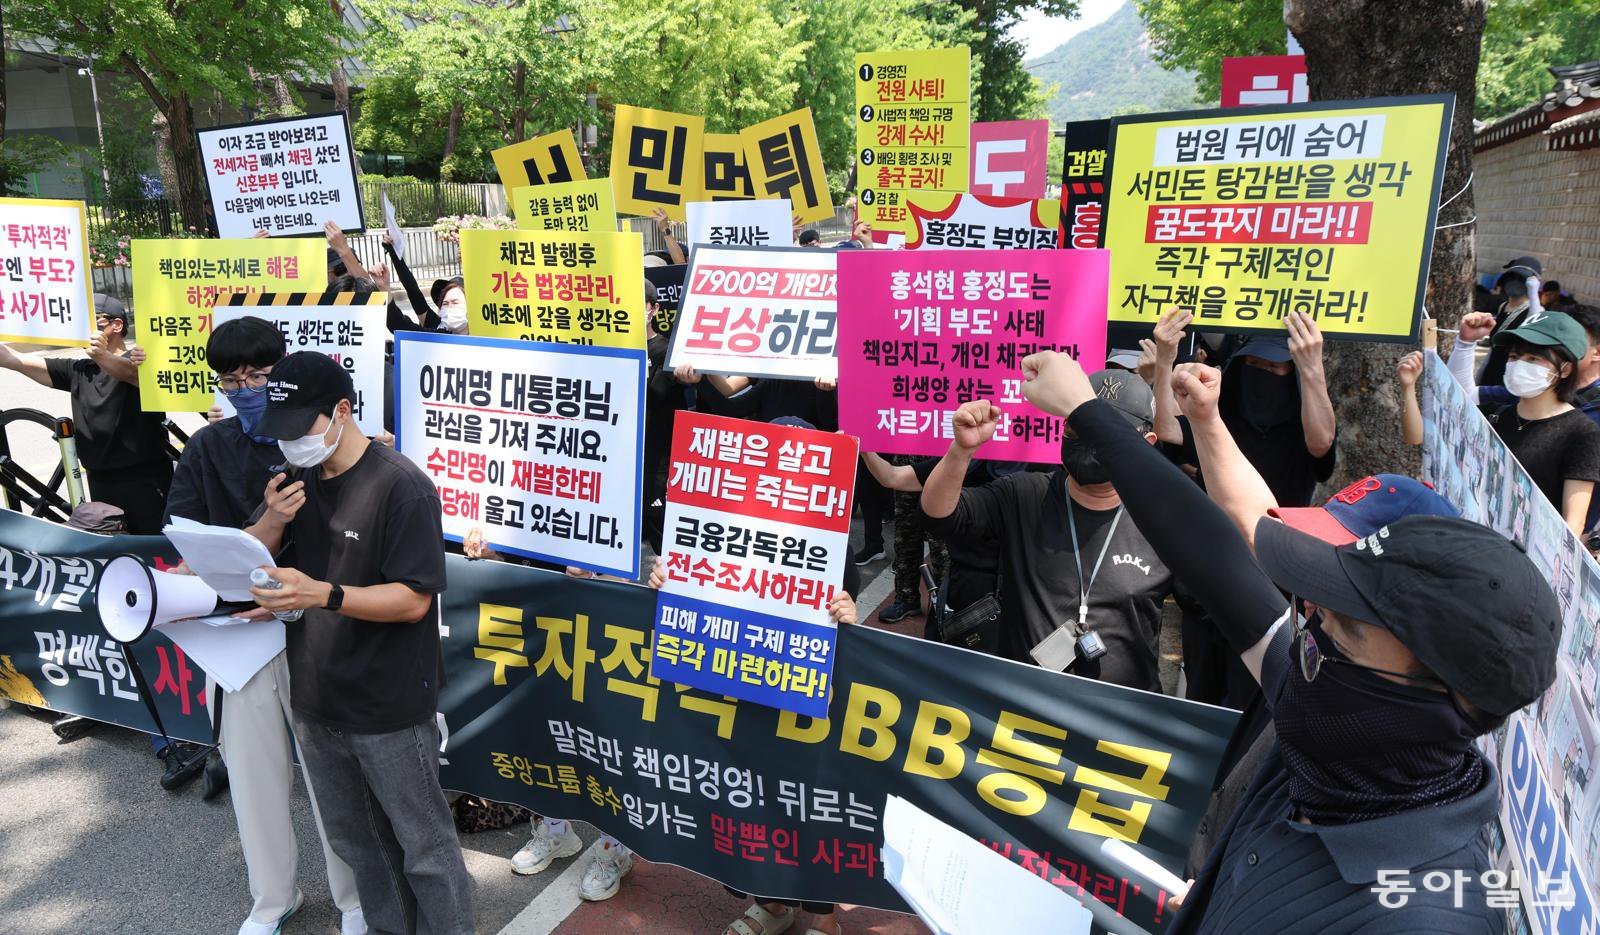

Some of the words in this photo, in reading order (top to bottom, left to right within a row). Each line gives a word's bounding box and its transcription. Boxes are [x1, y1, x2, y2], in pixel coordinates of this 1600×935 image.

[877, 65, 907, 79] 경영진
[877, 79, 906, 102] 전원
[909, 78, 945, 101] 사퇴!
[877, 109, 907, 122] 사법적
[909, 108, 930, 122] 책임
[932, 108, 953, 122] 규명
[218, 135, 242, 153] 이자
[245, 132, 266, 150] 조금
[268, 125, 328, 148] 받아보려고
[877, 124, 906, 146] 강제
[909, 124, 945, 146] 수사!
[1176, 128, 1228, 163] 법원
[1235, 124, 1297, 158] 뒤에
[1304, 120, 1368, 158] 숨어
[212, 154, 259, 176] 전세자금
[261, 152, 286, 168] 빼서
[288, 148, 313, 166] 채권
[315, 144, 340, 165] 샀던
[628, 125, 688, 206] 민
[877, 152, 896, 165] 배임
[899, 152, 917, 165] 횡령
[920, 153, 939, 165] 조사
[942, 153, 952, 165] 및
[1068, 149, 1107, 177] 검찰
[236, 173, 279, 193] 신혼부부
[282, 169, 322, 189] 입니다.
[877, 167, 906, 188] 출국
[909, 167, 944, 189] 금지!
[1127, 168, 1206, 202] 서민돈
[1215, 164, 1336, 200] 탕감받을
[1344, 161, 1412, 198] 생각
[225, 197, 265, 213] 다음달에
[266, 193, 297, 209] 아이도
[299, 189, 340, 206] 나오는데
[529, 198, 550, 217] 갚을
[553, 195, 574, 214] 능력
[576, 192, 599, 212] 없이
[253, 217, 272, 230] 너무
[274, 212, 317, 230] 힘드네요.
[709, 226, 769, 246] 증권사는
[926, 219, 986, 248] 홍정도
[1154, 206, 1263, 241] 꿈도꾸지
[1270, 205, 1360, 240] 마라!!
[3, 224, 71, 251] '투자적격'
[29, 256, 75, 283] 부도?
[159, 258, 262, 279] 책임있는자세로
[266, 256, 299, 279] 해결
[500, 241, 536, 266] 채권
[541, 242, 597, 268] 발행후
[1155, 246, 1210, 279] 즉각
[1215, 247, 1335, 282] 구체적인
[491, 271, 529, 299] 기습
[535, 273, 621, 305] 법정관리,
[695, 269, 779, 296] 7900억
[890, 269, 955, 301] 홍석현
[961, 270, 1052, 301] 홍정도는
[11, 291, 72, 324] 사기다!
[481, 303, 532, 328] 애초에
[537, 305, 571, 330] 갚을
[577, 308, 631, 333] 생각은
[1121, 283, 1227, 319] 자구책을
[1234, 286, 1368, 323] 공개하라!
[150, 316, 193, 336] 다음주
[297, 320, 334, 346] 생각도
[338, 320, 364, 346] 없는
[894, 306, 941, 337] '기획
[948, 308, 998, 337] 부도'
[1004, 309, 1045, 338] 사태
[862, 339, 945, 372] 책임지고,
[950, 341, 989, 369] 개인
[419, 364, 493, 407] 이재명
[500, 372, 619, 426] 대통령님,
[892, 375, 950, 403] 희생양
[424, 409, 483, 444] 관심을
[488, 418, 529, 451] 가져
[535, 423, 608, 463] 주세요.
[688, 427, 769, 467] 재벌은
[778, 440, 832, 476] 살고
[426, 447, 505, 486] 수만명이
[510, 459, 601, 504] 재벌한테
[670, 461, 747, 502] 개미는
[755, 474, 848, 518] 죽는다!
[436, 486, 480, 521] 당해
[484, 495, 524, 529] 울고
[530, 503, 623, 549] 있습니다.
[675, 516, 828, 572] 금융감독원은
[666, 551, 835, 611] 전수조사하라!
[660, 605, 697, 634] 피해
[702, 615, 740, 644] 개미
[744, 624, 785, 654] 구제
[789, 633, 831, 664] 방안
[34, 629, 139, 701] 명백한
[656, 633, 706, 671] 즉각
[711, 647, 828, 698] 마련하라!
[547, 719, 623, 776] 말로만
[632, 746, 765, 809] 책임경영!
[777, 779, 878, 832] 뒤로는
[490, 751, 581, 795] 중앙그룹
[586, 774, 698, 840] 총수일가는
[711, 812, 800, 867] 말뿐인
[811, 838, 878, 878] 사과
